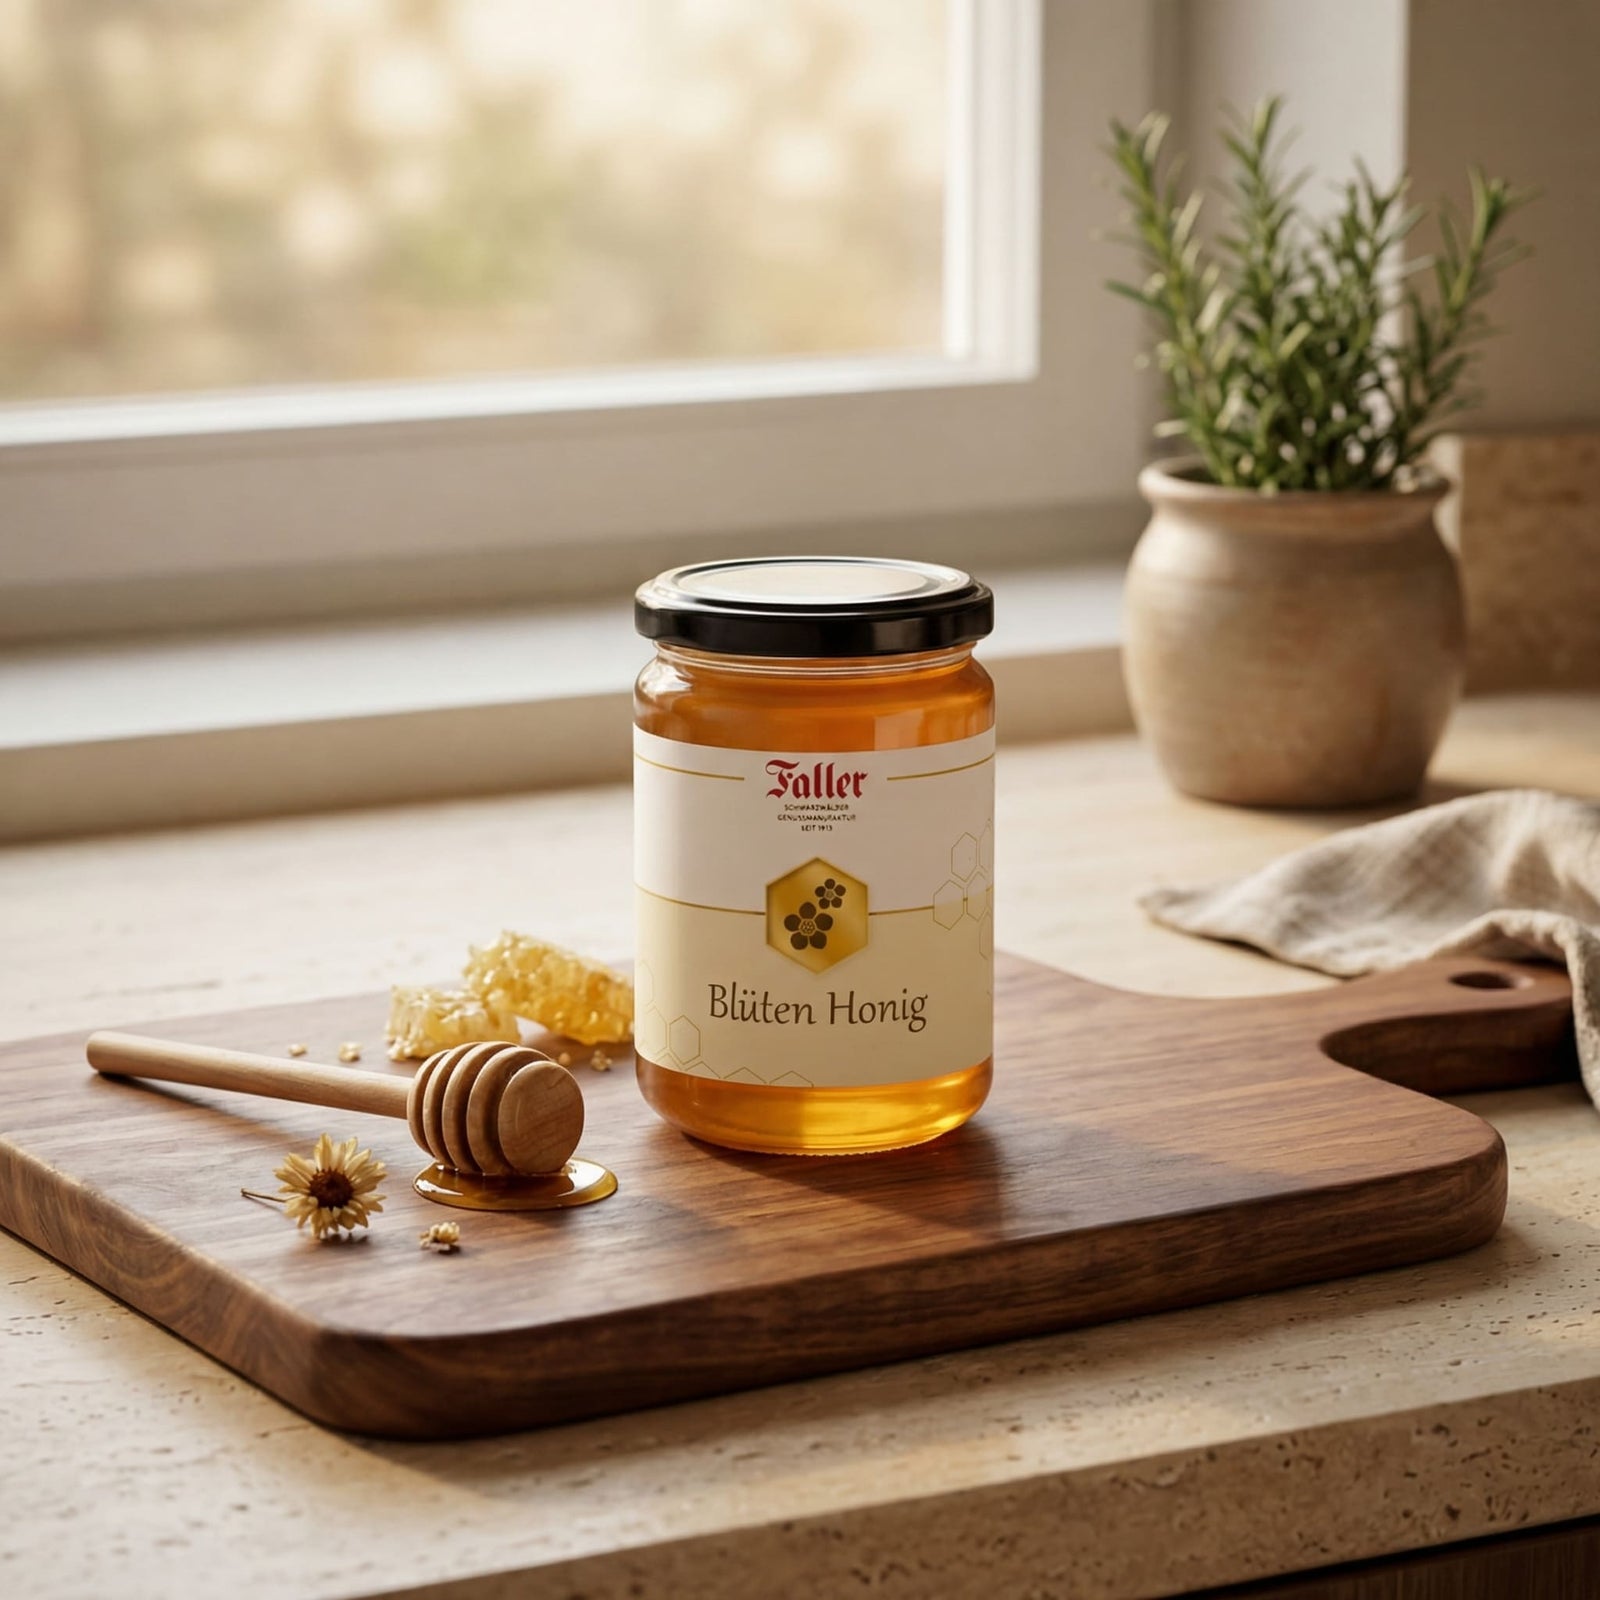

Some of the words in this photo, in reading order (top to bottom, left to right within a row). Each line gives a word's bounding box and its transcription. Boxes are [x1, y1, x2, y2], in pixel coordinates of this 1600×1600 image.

[765, 759, 868, 799] Faller
[708, 981, 817, 1025] Blüten
[827, 988, 928, 1033] Honig
